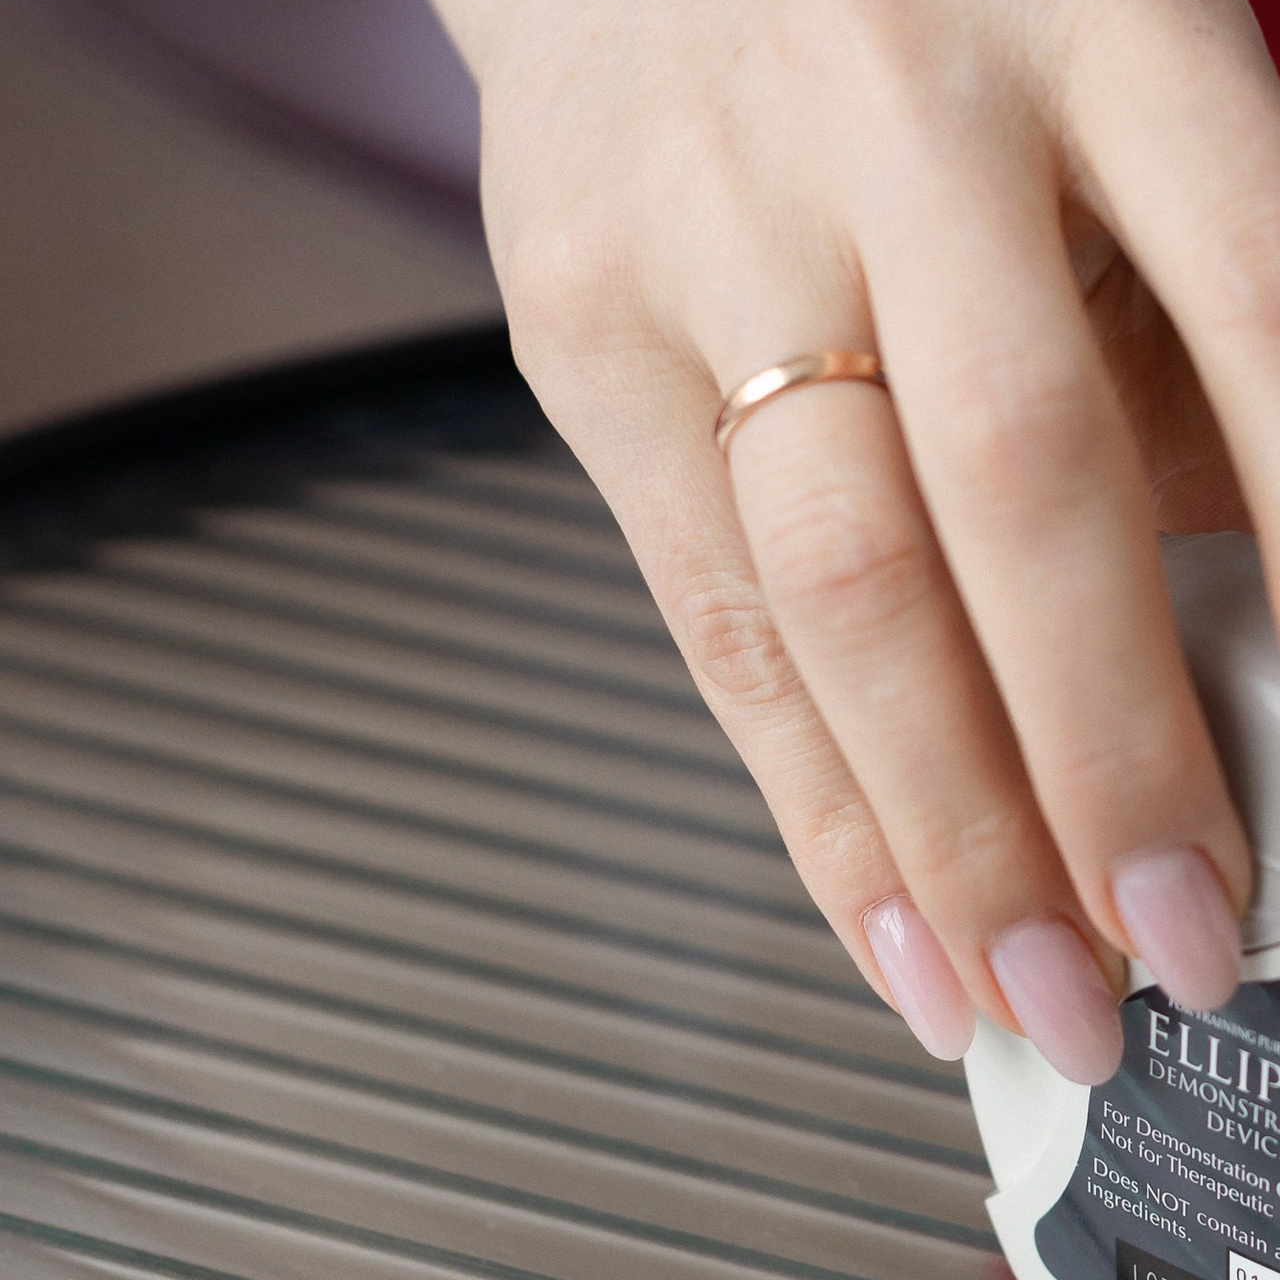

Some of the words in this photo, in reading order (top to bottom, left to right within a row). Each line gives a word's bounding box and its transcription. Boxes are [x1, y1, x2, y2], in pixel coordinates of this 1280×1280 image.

[1101, 1123, 1133, 1154] Not
[1138, 1141, 1163, 1166] for
[1167, 1153, 1274, 1218] Therapeutic
[1103, 1100, 1130, 1127] For
[1136, 1116, 1270, 1192] Demonstration
[1087, 1176, 1192, 1243] ingredients.
[1093, 1157, 1139, 1194] Does
[1146, 1183, 1190, 1217] NOT
[1196, 1212, 1267, 1253] contain
